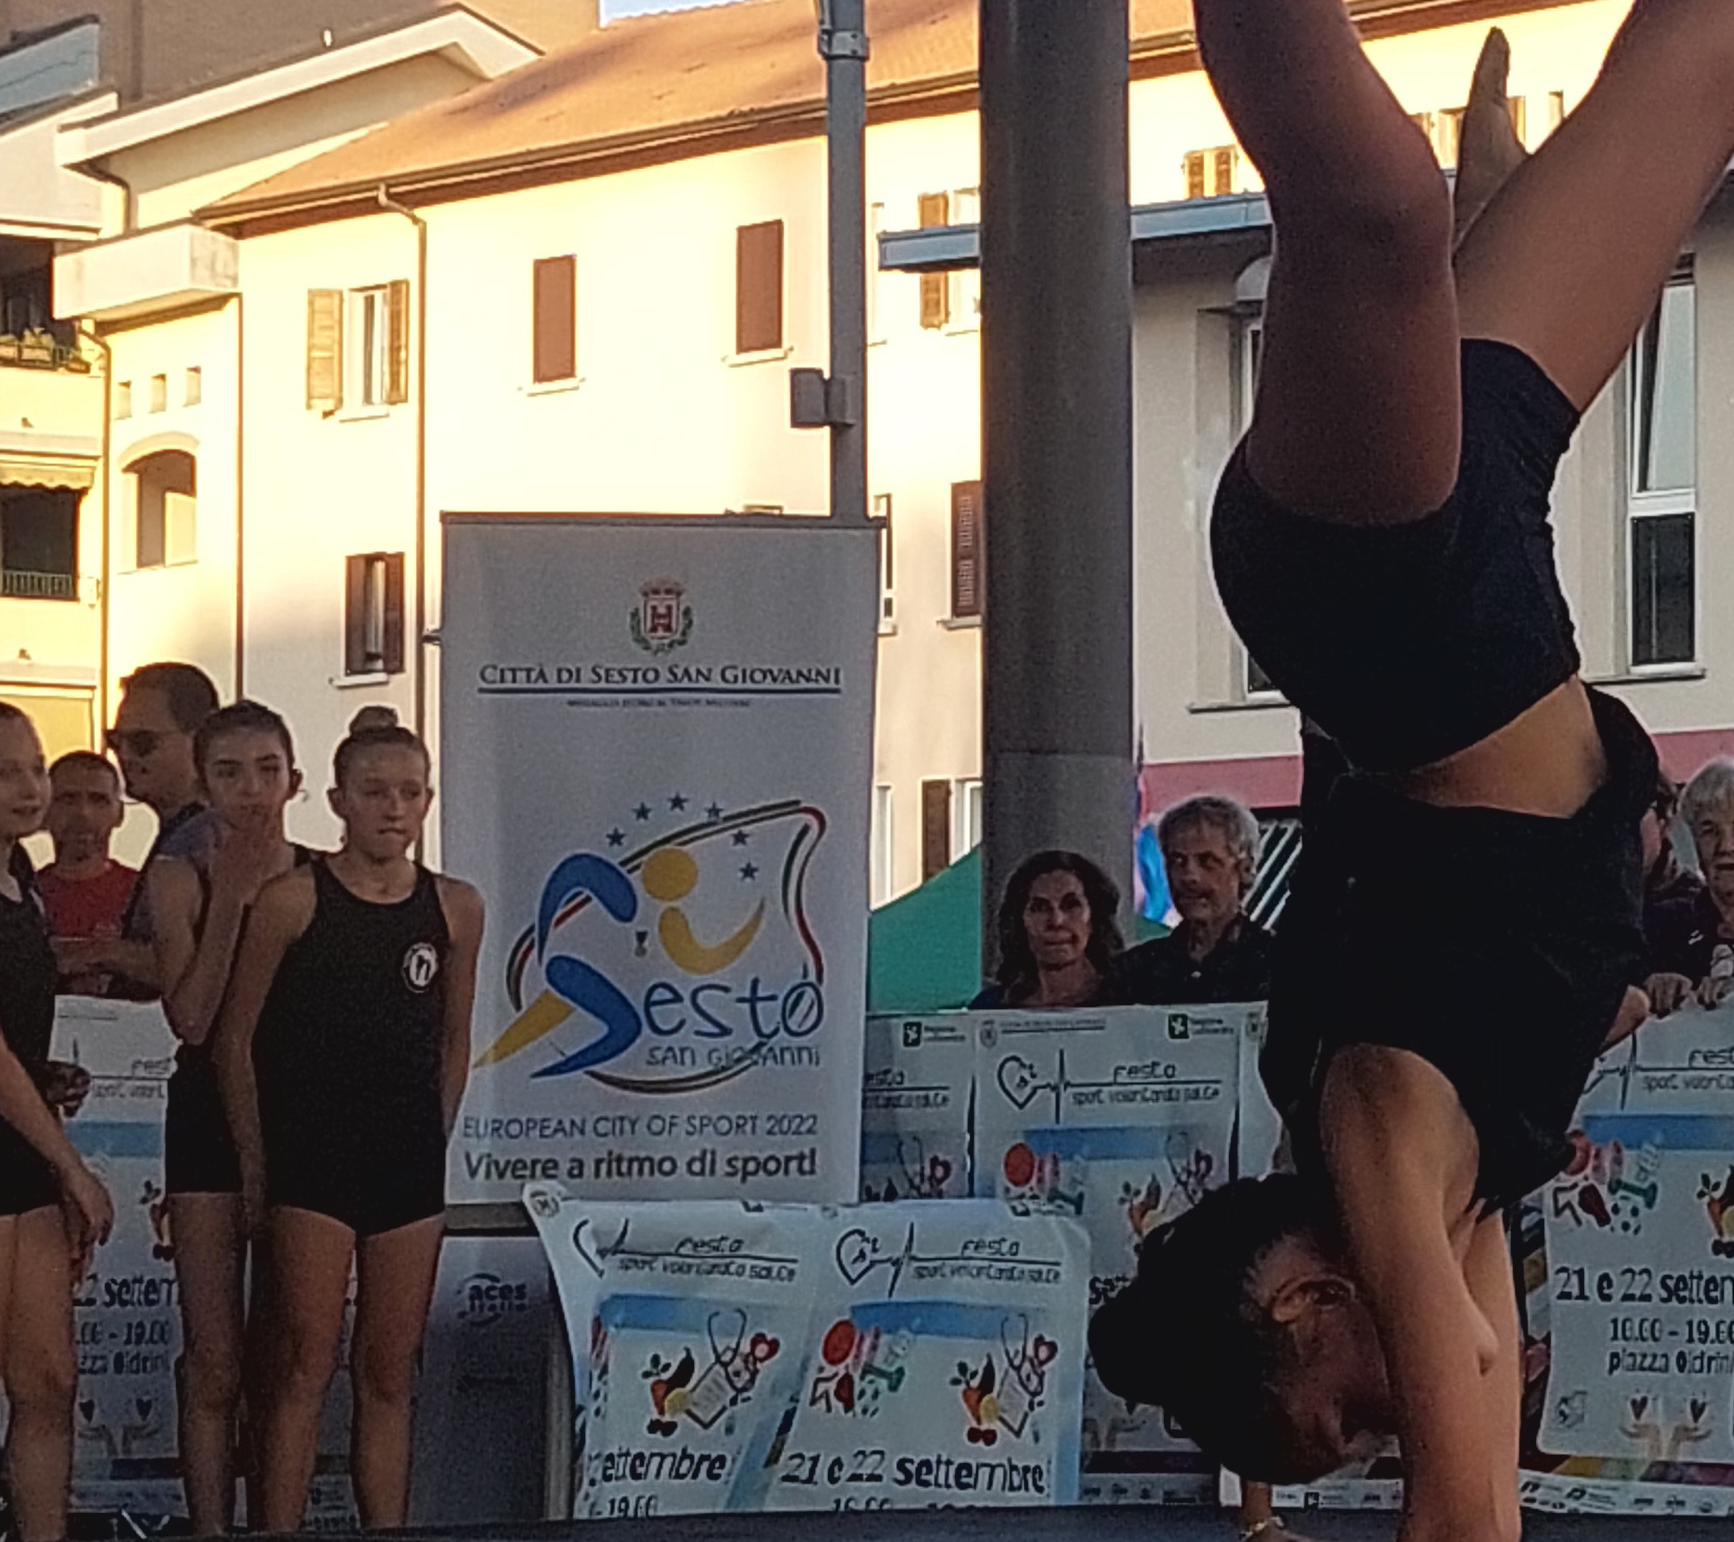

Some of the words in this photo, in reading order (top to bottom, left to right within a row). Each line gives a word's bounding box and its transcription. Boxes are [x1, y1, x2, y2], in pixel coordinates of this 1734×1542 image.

[667, 663, 712, 683] SAN
[720, 665, 841, 685] GIOVANNI
[462, 1116, 586, 1140] EUROPEAN
[593, 1115, 639, 1138] CITY
[646, 1115, 678, 1137] OF
[685, 1114, 758, 1137] SPORT
[766, 1113, 819, 1136] 2022
[464, 1150, 558, 1180] Vivere
[566, 1159, 585, 1179] a
[593, 1149, 678, 1178] ritmo
[685, 1149, 716, 1177] di
[1555, 1266, 1590, 1301] 21
[1597, 1272, 1614, 1302] e
[1620, 1268, 1653, 1302] 22
[781, 1451, 818, 1485] 21
[846, 1449, 887, 1483] 22
[893, 1455, 1047, 1495] settembre
